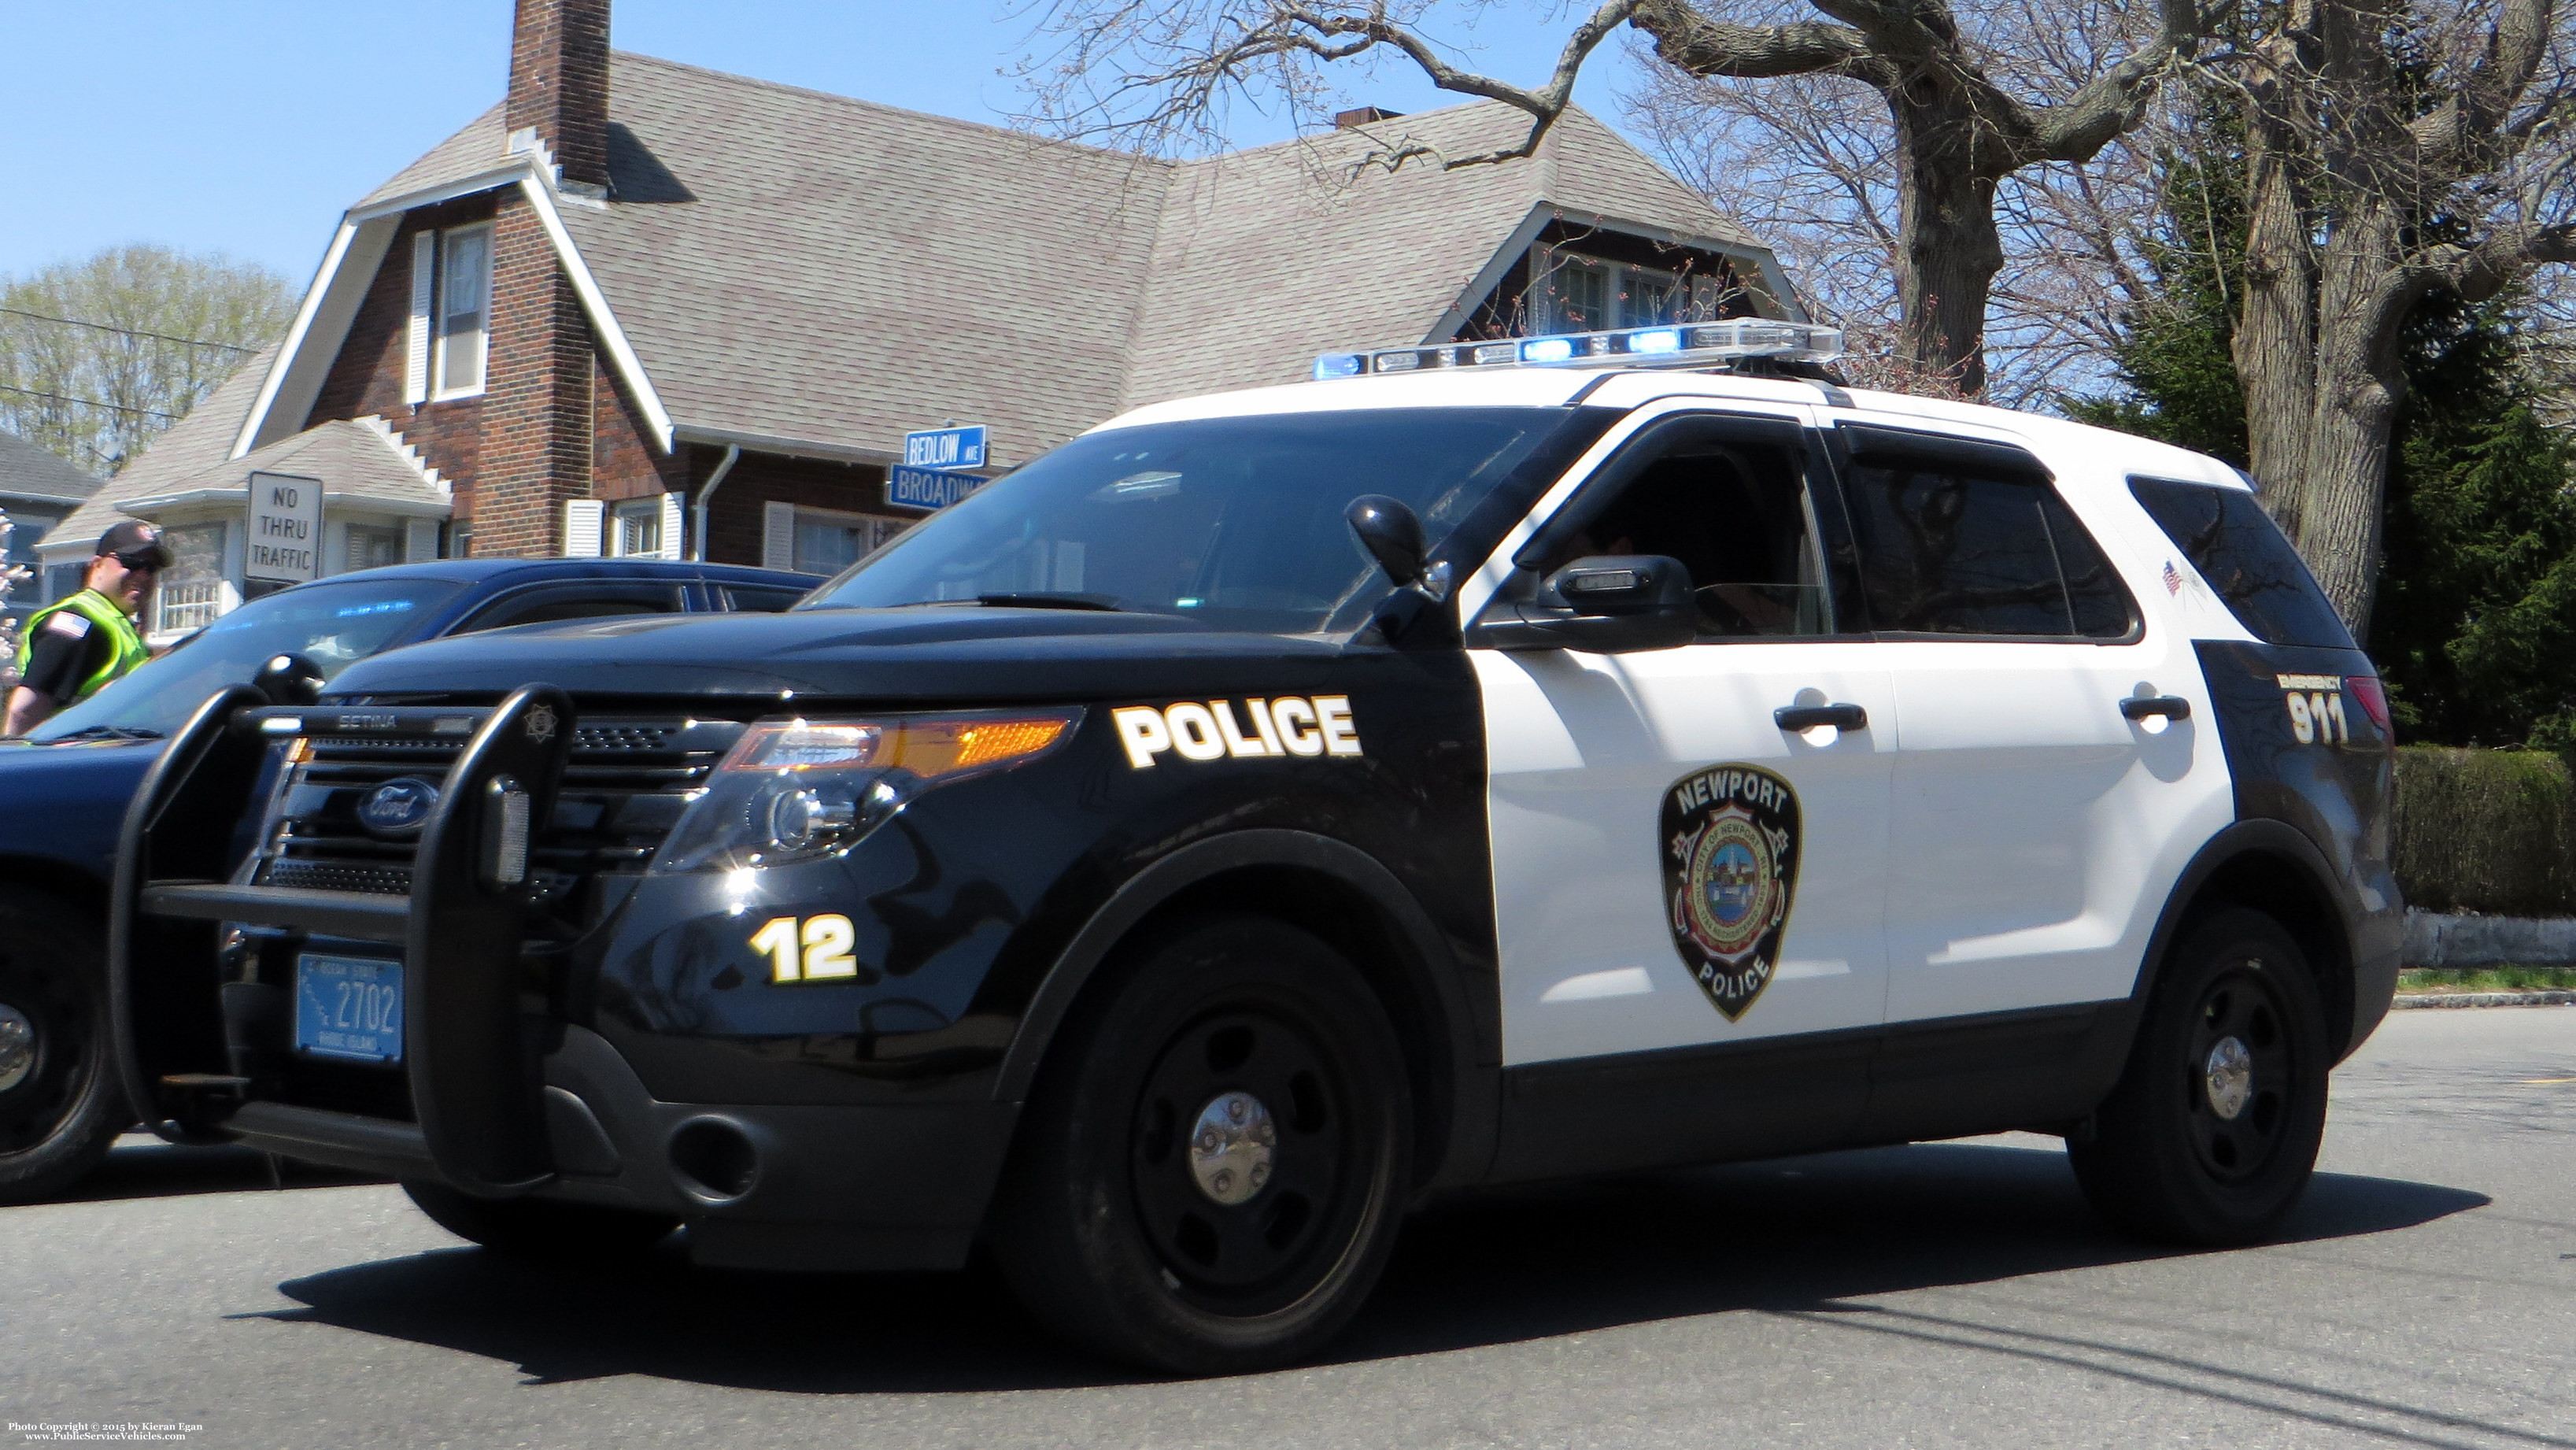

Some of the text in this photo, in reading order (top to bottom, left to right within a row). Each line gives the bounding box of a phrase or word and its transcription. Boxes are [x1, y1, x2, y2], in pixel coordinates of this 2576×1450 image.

[909, 434, 979, 465] BEDLOW AVE
[272, 487, 298, 508] NO
[261, 515, 309, 539] THRU
[253, 544, 311, 570] TRAFFIC
[1111, 694, 1364, 768] POLICE
[2287, 692, 2349, 745] 911
[370, 786, 419, 818] Ford
[1676, 770, 1787, 816] NEWPORT
[748, 913, 858, 982] 12
[1698, 954, 1770, 999] POLICE
[336, 981, 394, 1034] 2702
